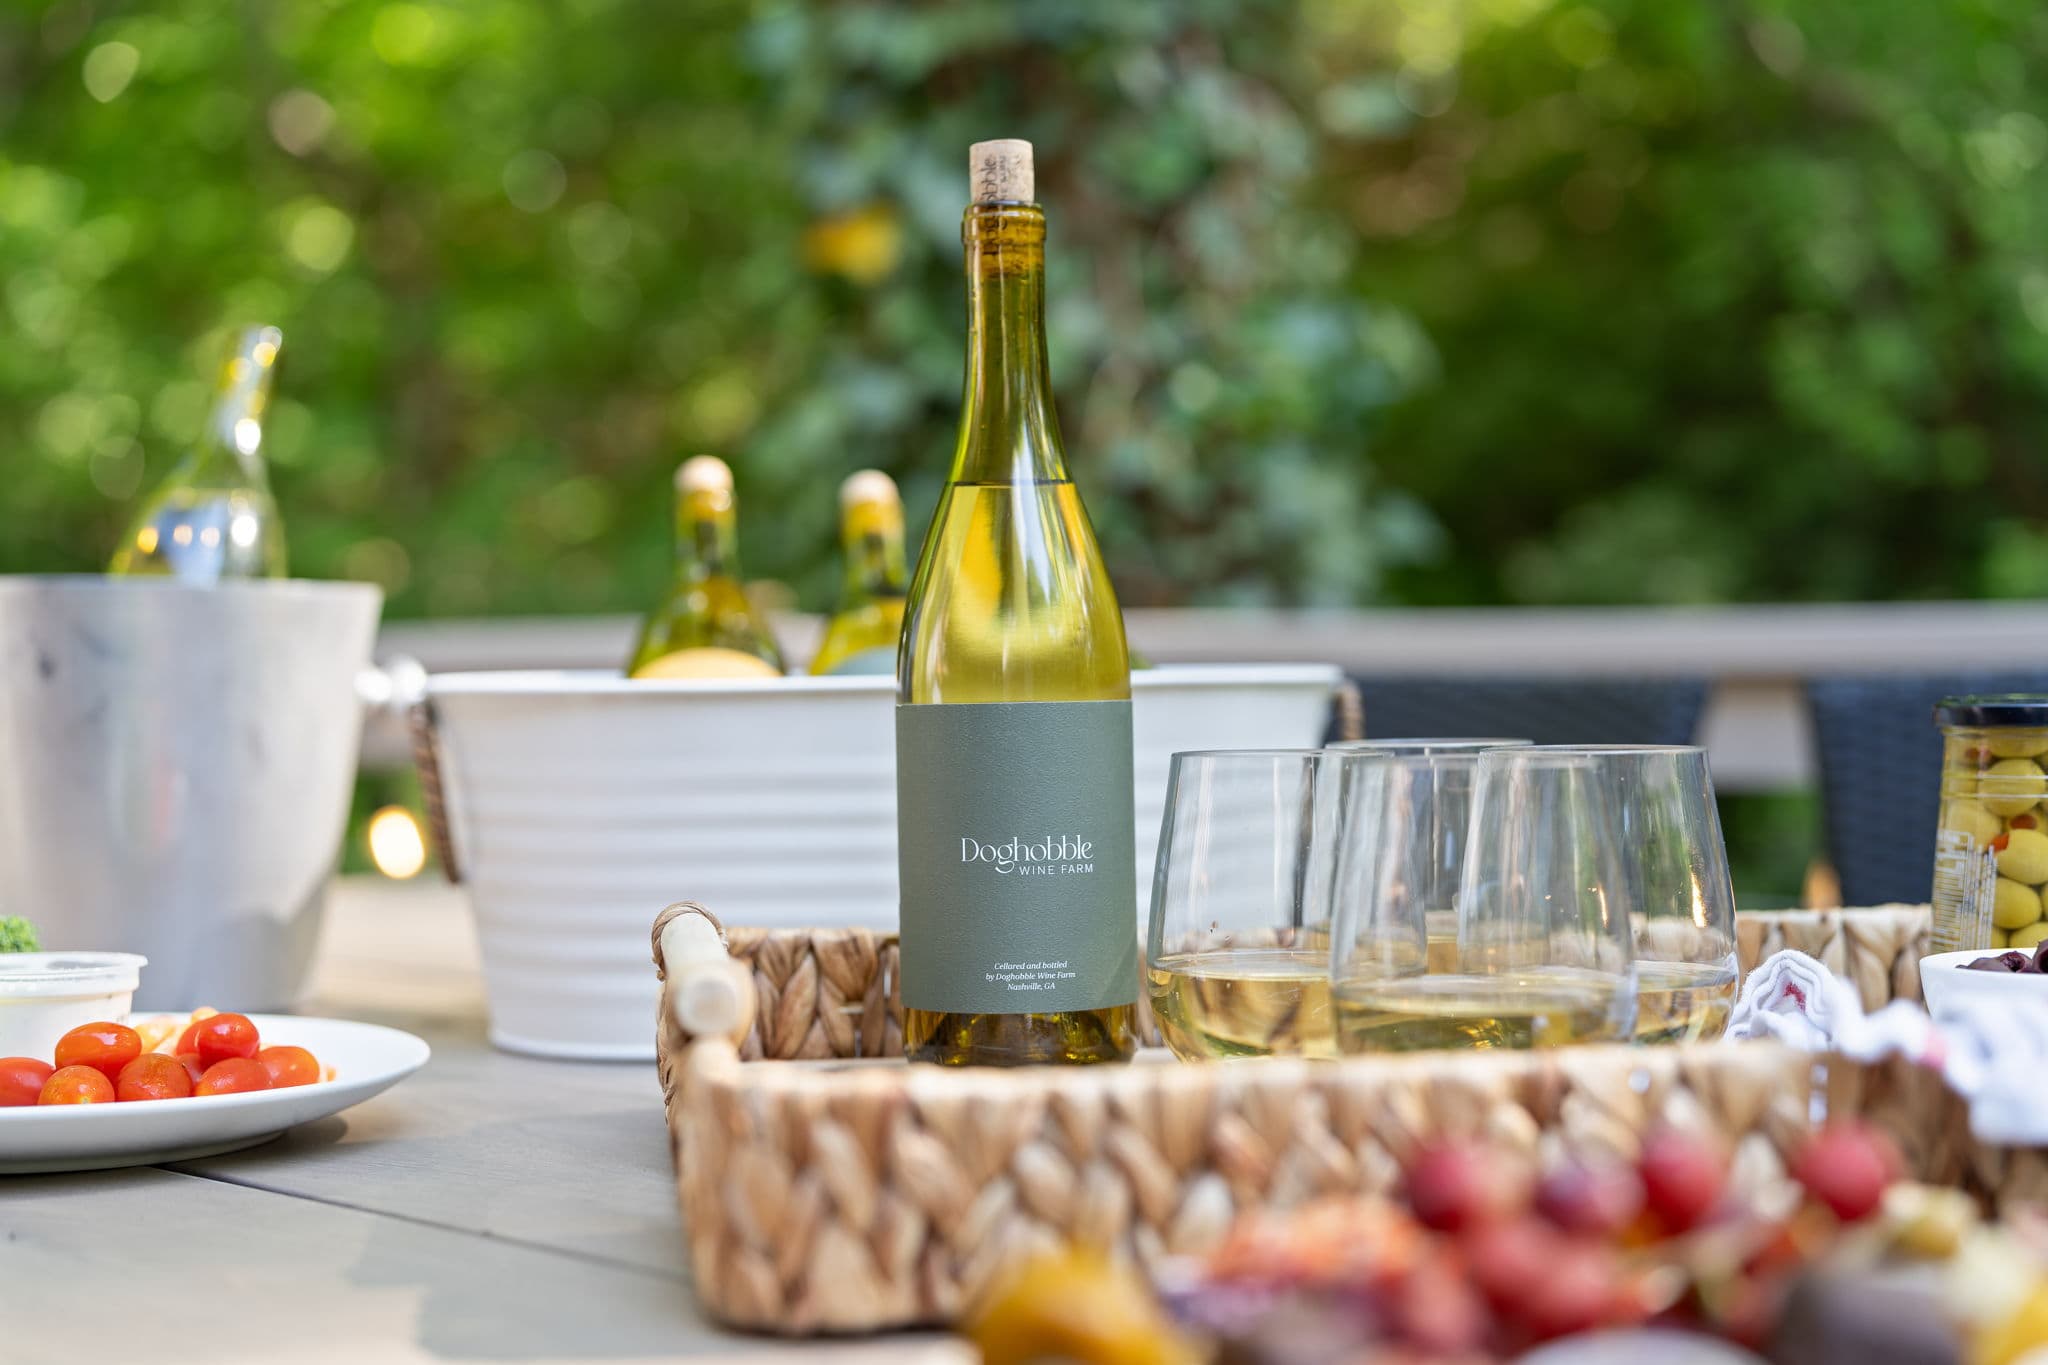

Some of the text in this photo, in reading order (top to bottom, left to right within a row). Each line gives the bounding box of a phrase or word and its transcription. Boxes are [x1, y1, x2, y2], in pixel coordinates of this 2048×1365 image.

[961, 834, 1094, 874] Doghobble
[1019, 863, 1094, 875] WINE FARM
[994, 960, 1068, 970] Cellared and bottled
[985, 971, 1076, 982] by Doghobble Wine Farm
[1007, 982, 1056, 991] Nashville, GA
